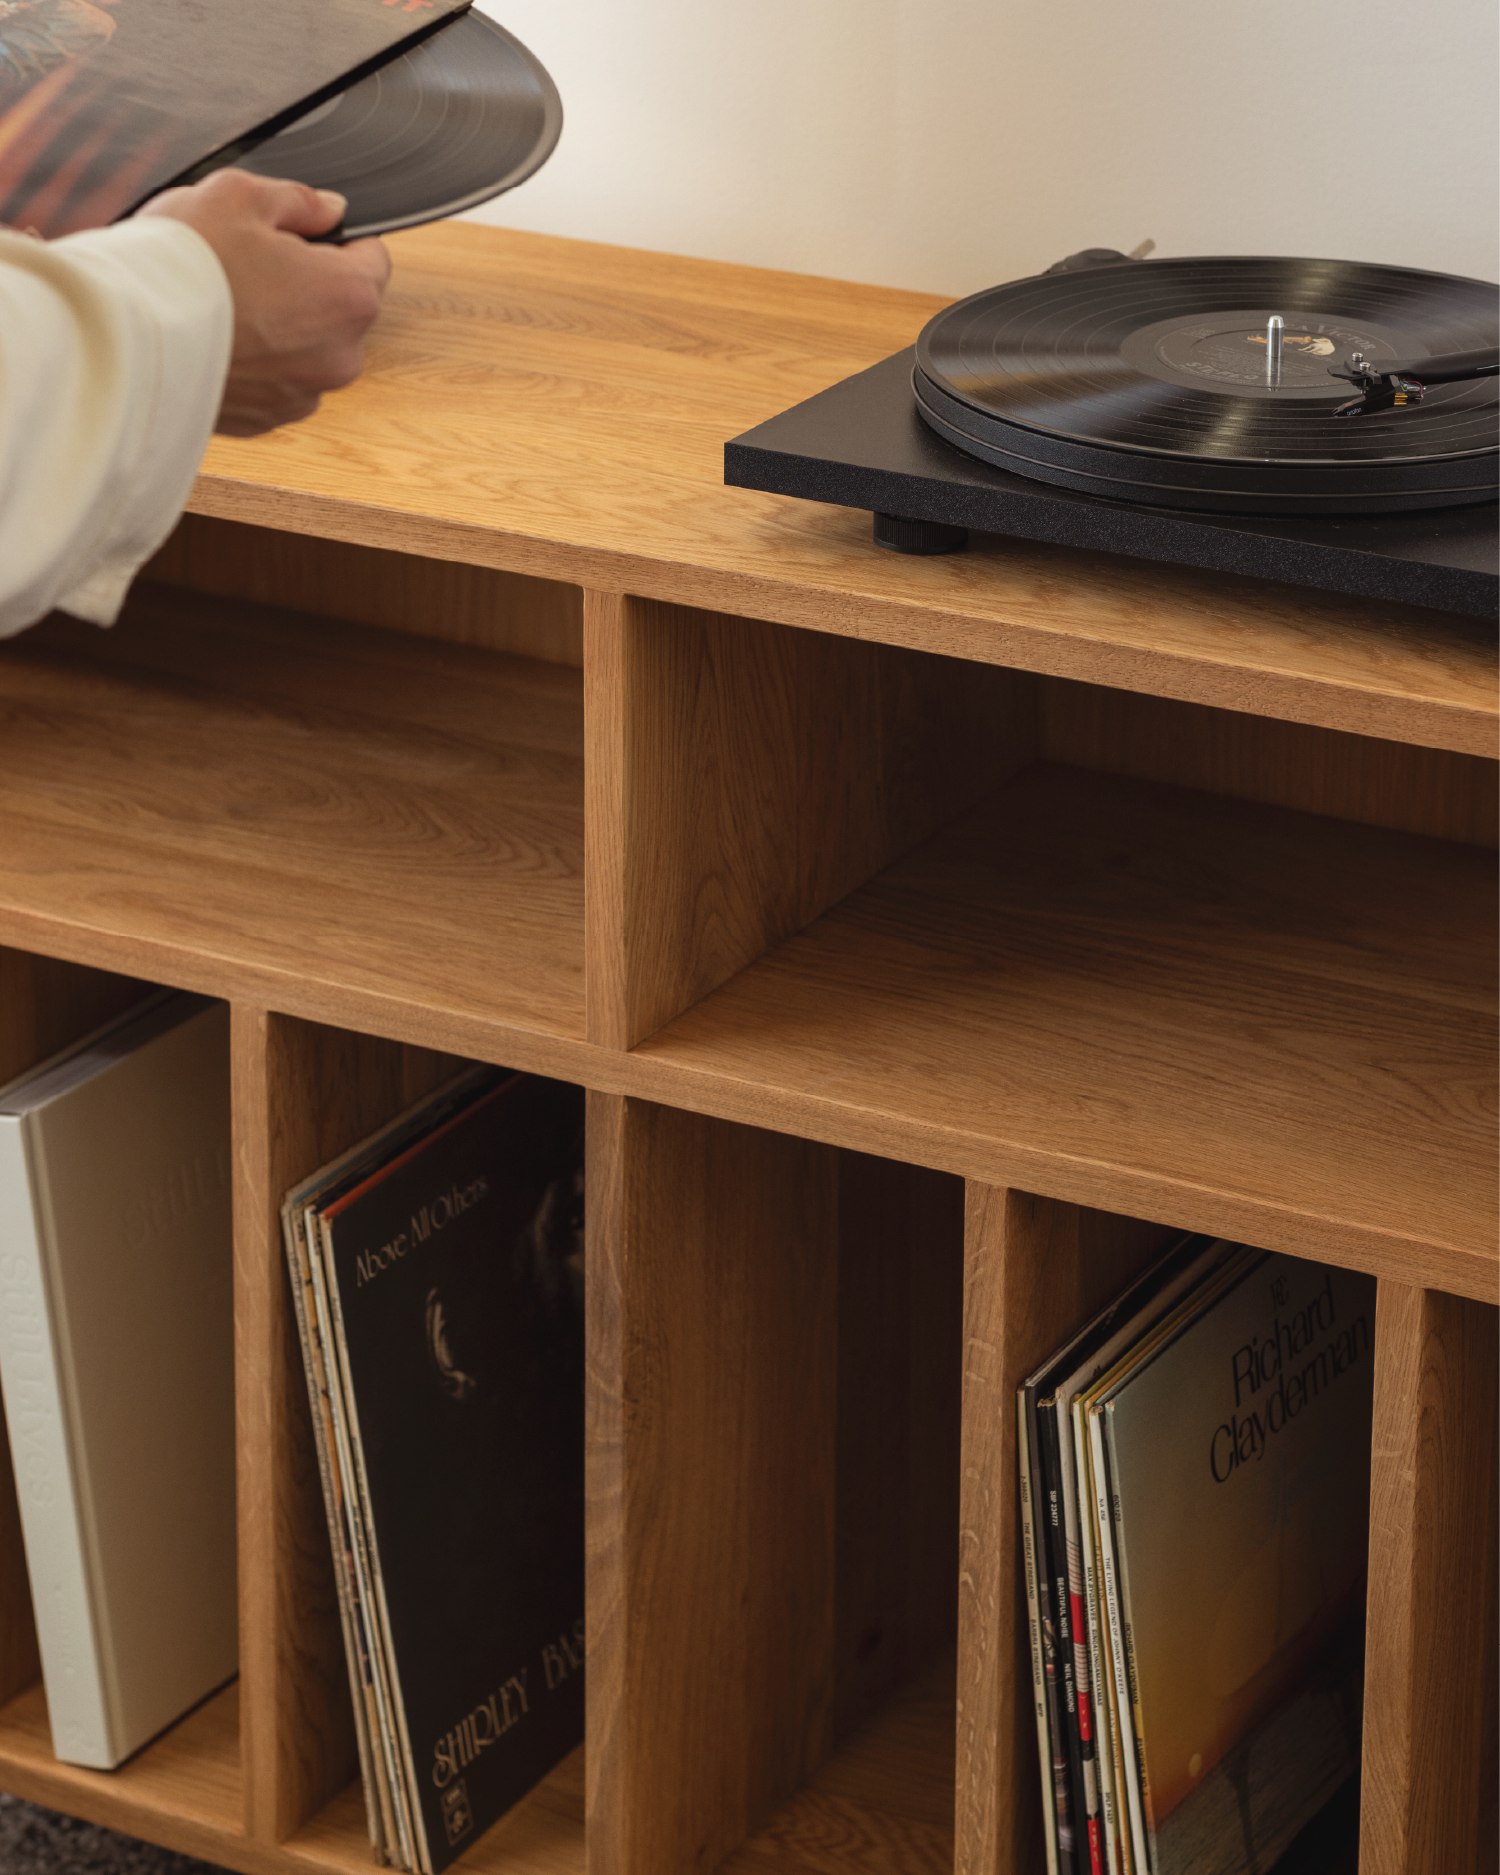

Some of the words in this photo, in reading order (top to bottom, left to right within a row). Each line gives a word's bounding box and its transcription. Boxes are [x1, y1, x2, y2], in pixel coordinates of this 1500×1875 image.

[1185, 362, 1259, 380] STEREO
[1346, 407, 1362, 416] ortofon
[356, 1233, 409, 1288] Above
[411, 1205, 432, 1248] All
[430, 1175, 489, 1230] Others
[1232, 1273, 1335, 1408] Richard
[1211, 1315, 1369, 1483] Clayderman
[1027, 1561, 1035, 1599] STREISAND
[1106, 1572, 1114, 1596] LIVING
[1057, 1577, 1067, 1616] BEAUTIFUL
[1088, 1583, 1097, 1621] BYGRAVES
[1109, 1598, 1117, 1626] LEGEND
[1030, 1619, 1038, 1645] BARBRA
[1060, 1617, 1069, 1638] NOISE
[1125, 1622, 1134, 1653] RICHARD
[1032, 1647, 1041, 1685] STREISAND
[1113, 1638, 1122, 1665] JOHNNY
[1064, 1663, 1072, 1679] NEIL
[1129, 1656, 1139, 1705] CLAYDERMAN
[1066, 1681, 1075, 1713] DIAMOND
[432, 1664, 529, 1788] SHIRLEY
